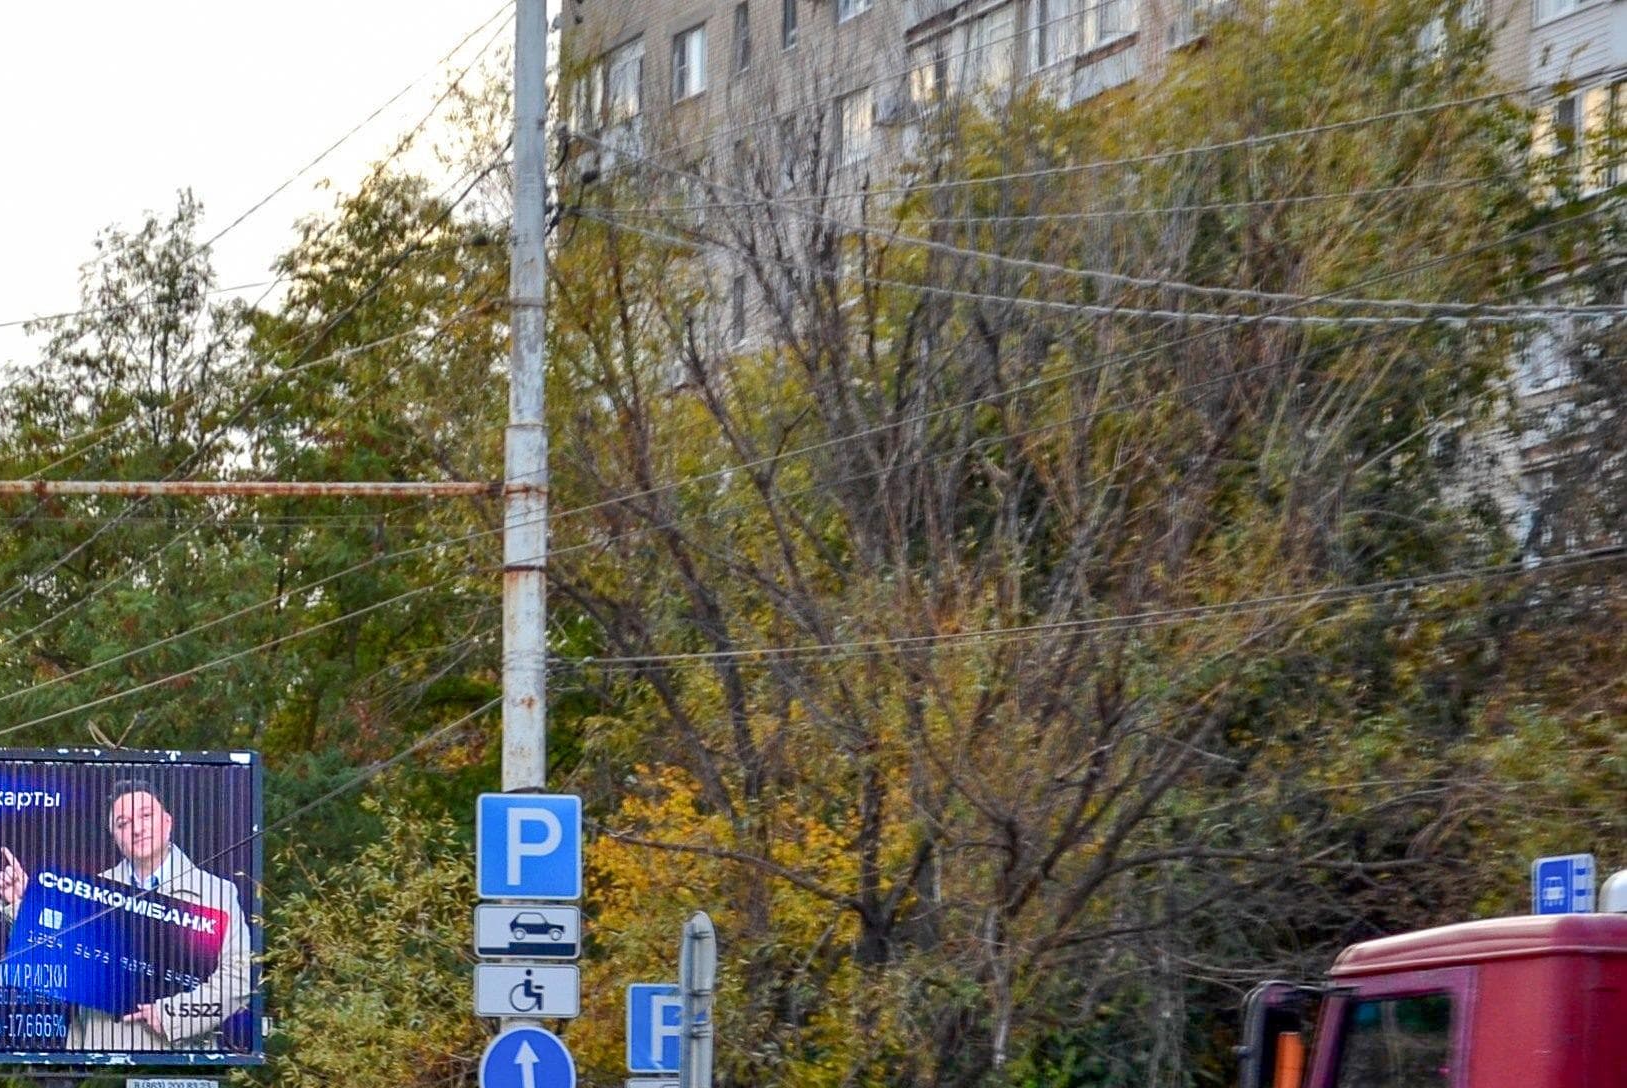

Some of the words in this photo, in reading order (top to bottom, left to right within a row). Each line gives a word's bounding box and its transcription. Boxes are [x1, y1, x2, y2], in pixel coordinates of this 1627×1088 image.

[506, 807, 563, 886] P
[38, 871, 217, 936] СОВКОМБАНК
[24, 963, 68, 989] РИСКИ
[178, 1002, 221, 1018] 5522
